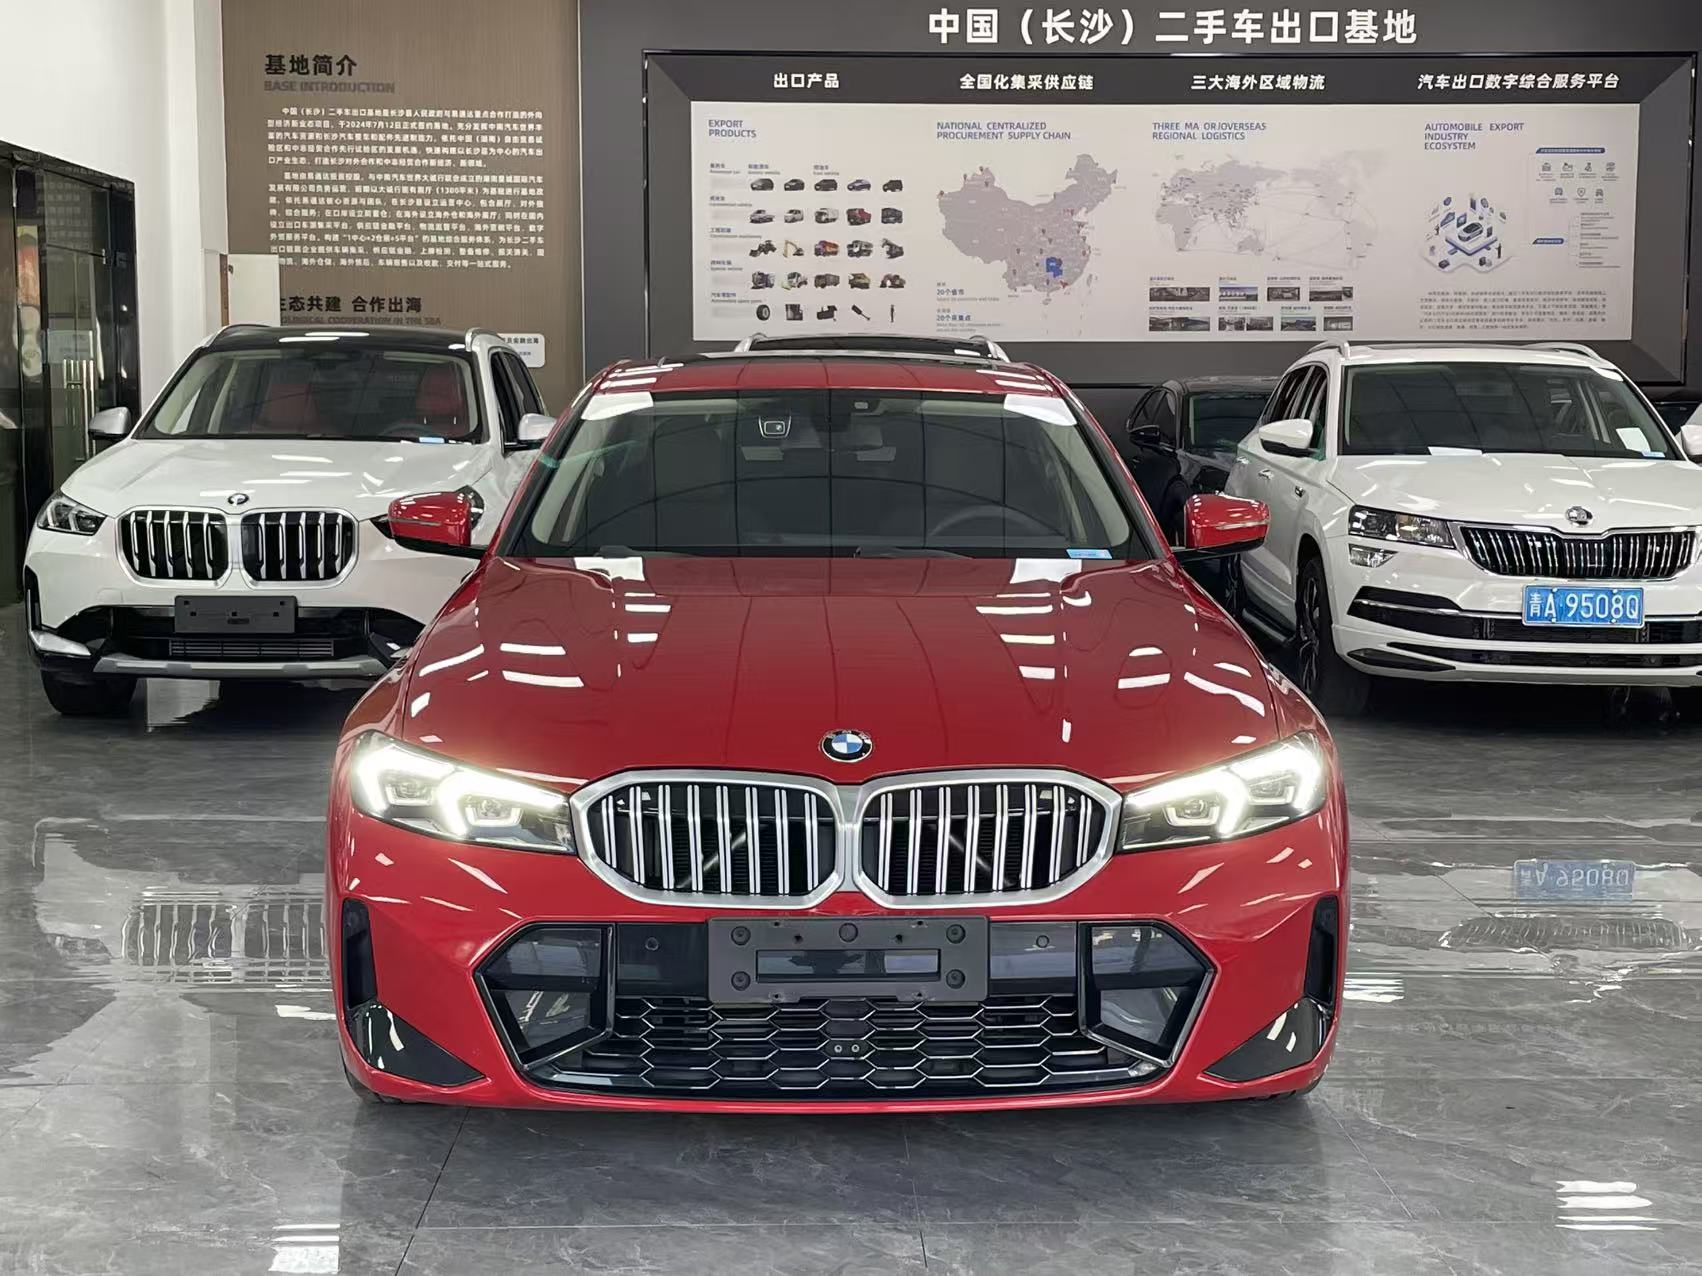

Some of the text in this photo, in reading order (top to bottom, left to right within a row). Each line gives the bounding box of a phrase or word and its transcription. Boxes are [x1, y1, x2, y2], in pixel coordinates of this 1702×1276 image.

[929, 8, 1416, 44] 中国（长沙）二手车出口基地
[265, 55, 356, 75] 基地简介
[774, 73, 839, 88] 出口产品
[960, 74, 1093, 90] 全国化集采供应链
[1191, 74, 1325, 90] 三大海外区域物流
[1418, 73, 1619, 89] 汽车出口数字综合服务平台
[709, 129, 756, 137] PRODUCTS
[987, 122, 1046, 130] CENTRALIZED
[1151, 121, 1181, 131] THREE
[1184, 121, 1200, 131] MA
[1425, 123, 1524, 131] AUTOMOBILE EXPORT
[1151, 131, 1246, 140] REGIONAL LOGISTICS
[352, 296, 422, 313] 合作出海
